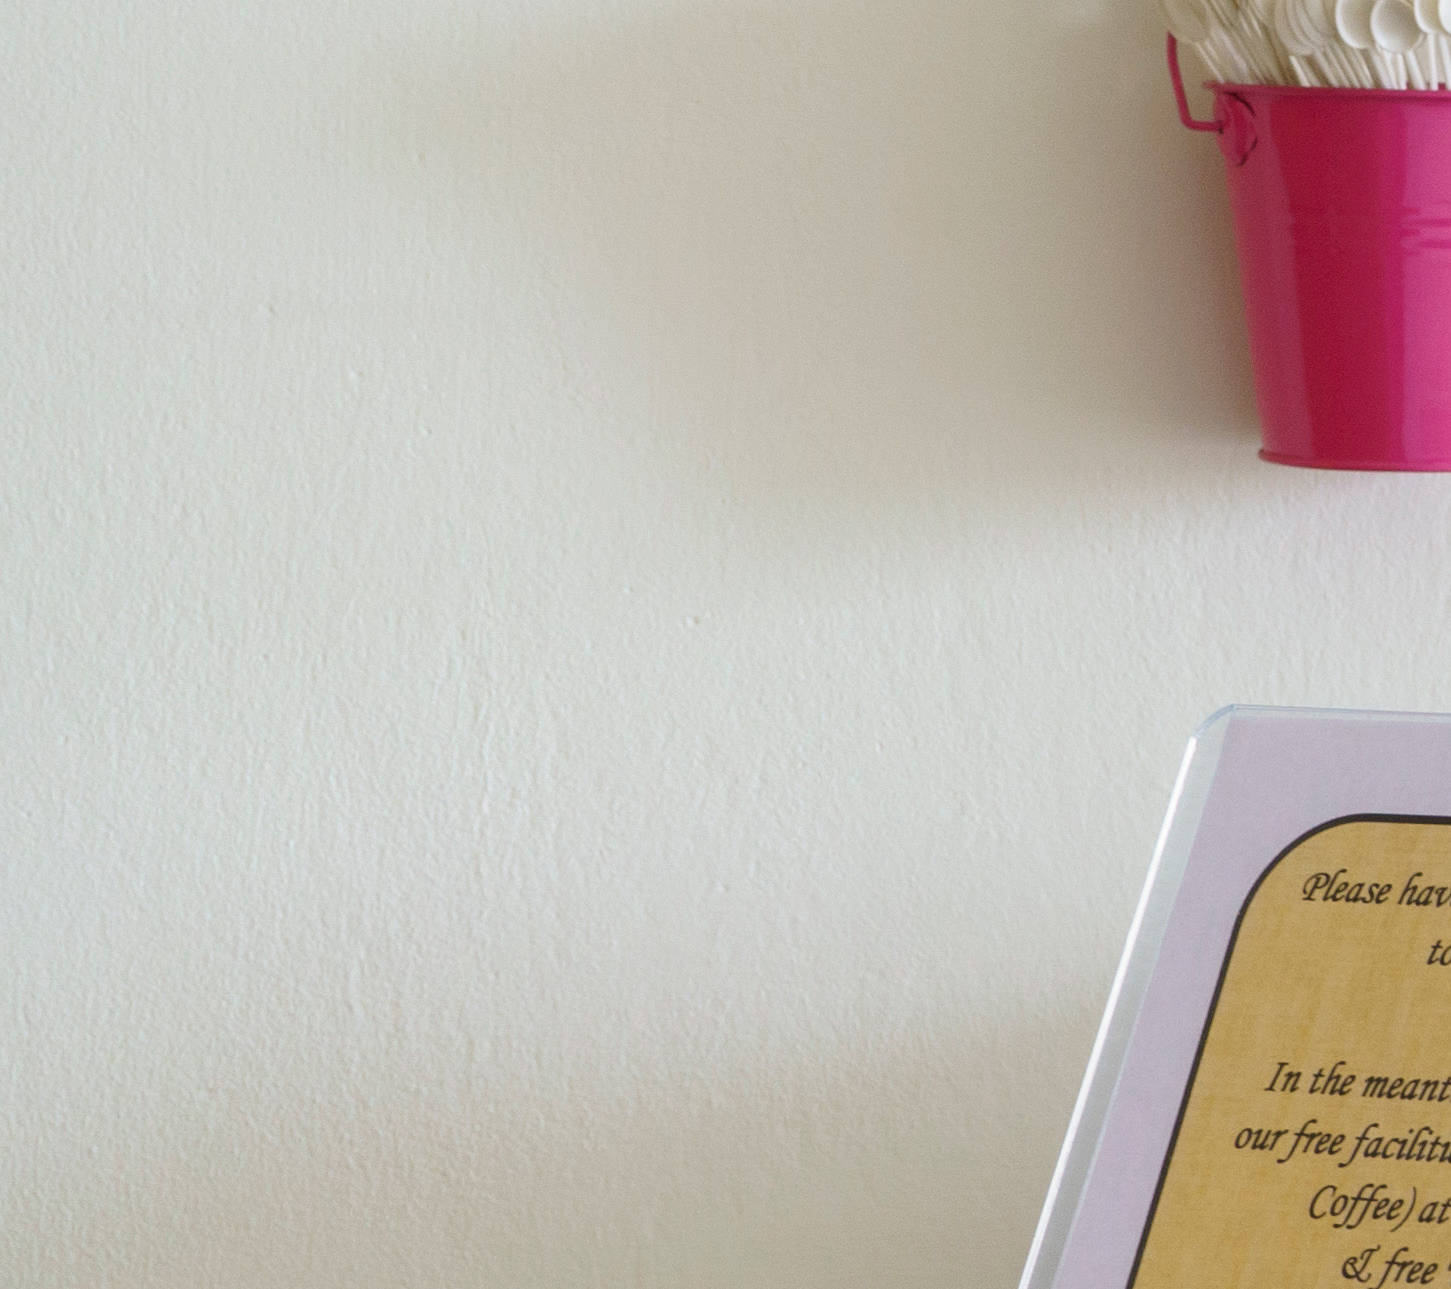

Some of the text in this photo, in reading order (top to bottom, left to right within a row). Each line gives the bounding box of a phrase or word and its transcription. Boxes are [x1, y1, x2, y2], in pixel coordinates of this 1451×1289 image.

[1302, 868, 1393, 905] Please
[1264, 1061, 1302, 1093] In
[1308, 1060, 1357, 1097] the
[1234, 1127, 1289, 1151] our
[1276, 1118, 1346, 1164] free
[1308, 1182, 1417, 1232] Coffee)
[1341, 1245, 1381, 1283] &
